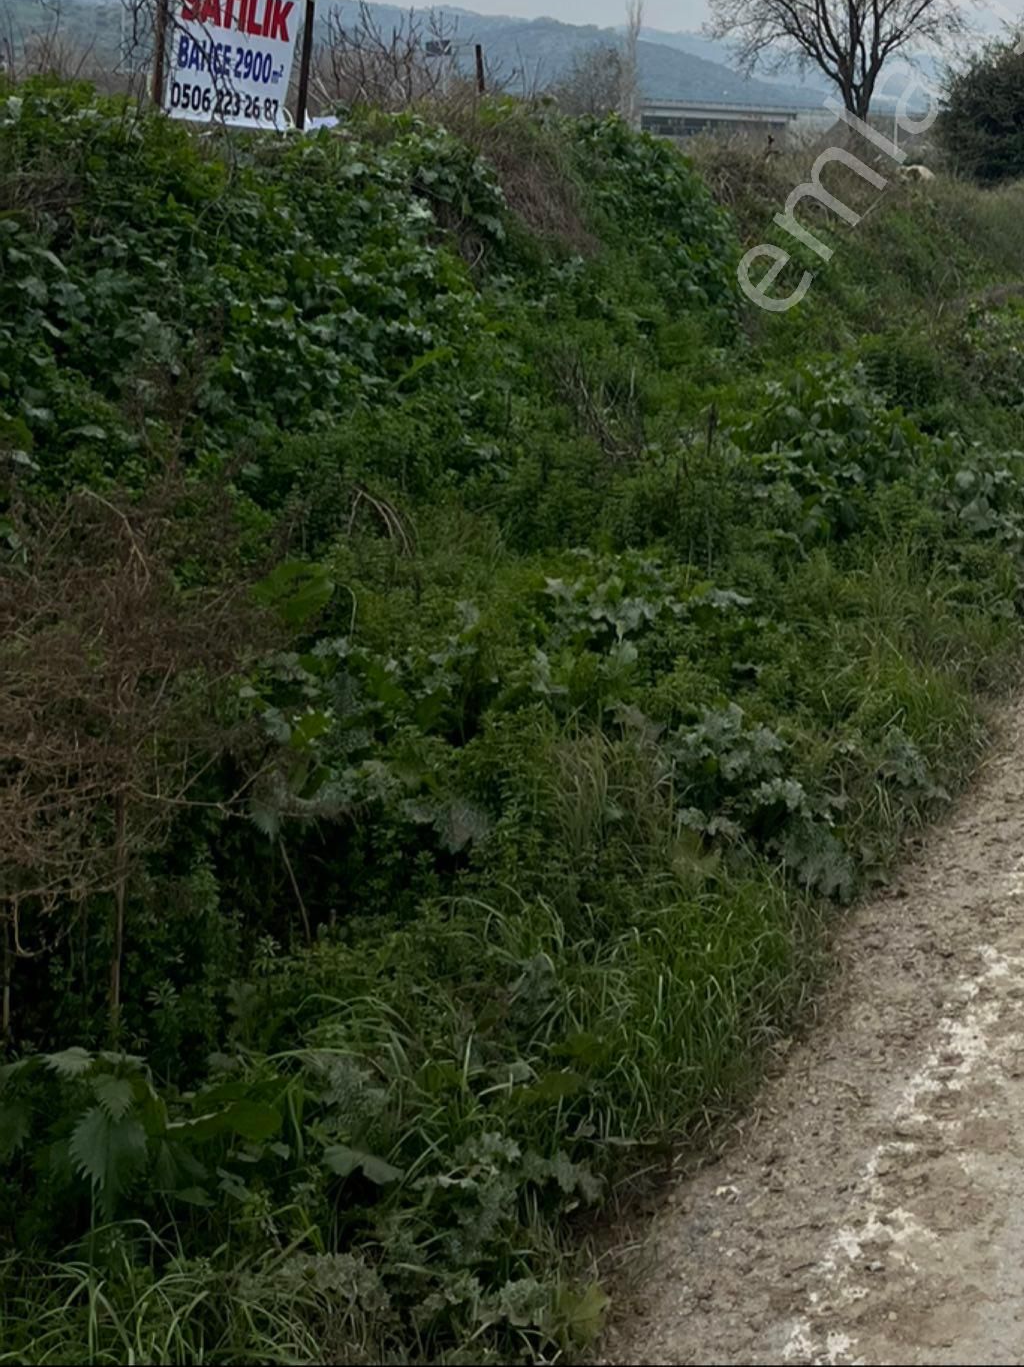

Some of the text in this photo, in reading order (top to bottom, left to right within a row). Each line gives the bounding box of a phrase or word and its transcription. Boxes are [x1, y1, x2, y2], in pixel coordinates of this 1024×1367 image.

[170, 82, 211, 112] 0506
[245, 94, 260, 120] 26
[264, 97, 279, 122] 87
